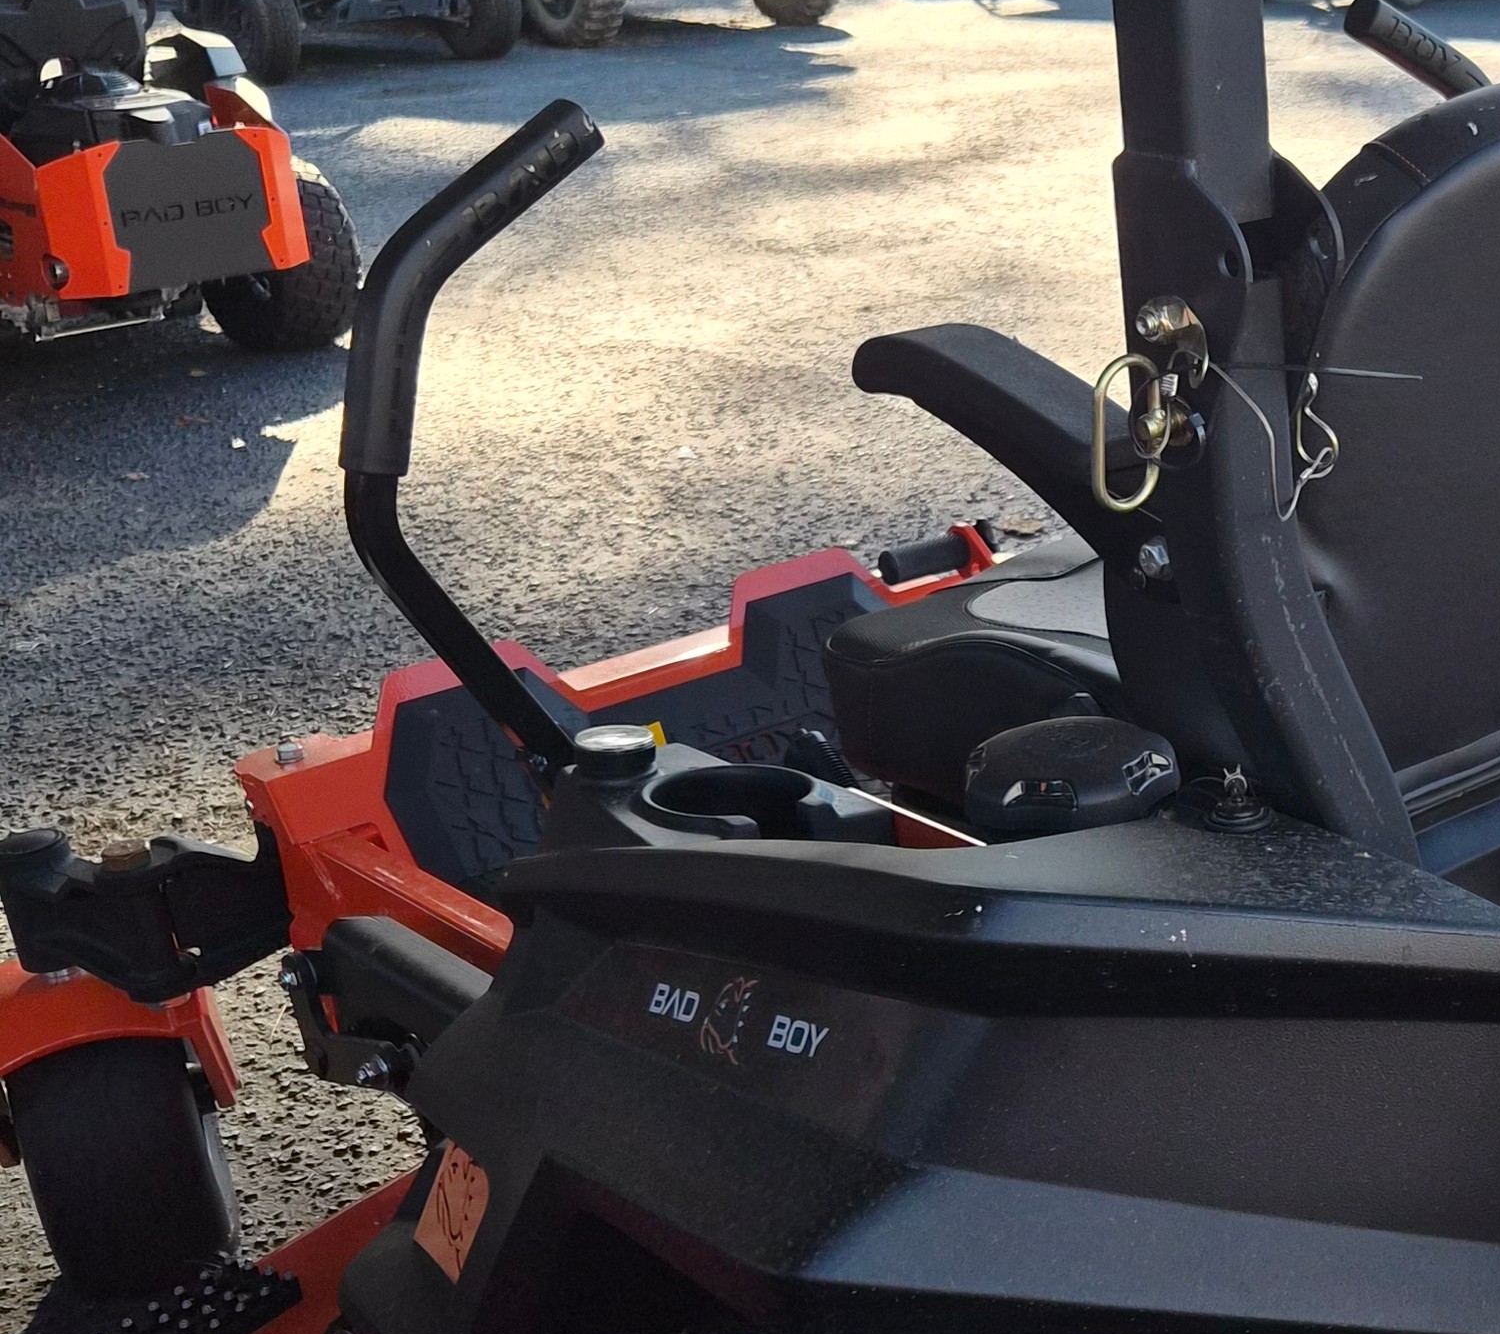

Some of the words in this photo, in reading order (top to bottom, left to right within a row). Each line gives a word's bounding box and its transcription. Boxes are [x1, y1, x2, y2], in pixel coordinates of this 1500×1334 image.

[195, 194, 253, 217] BOY
[648, 982, 700, 1023] BAD
[767, 1014, 830, 1058] BOY
